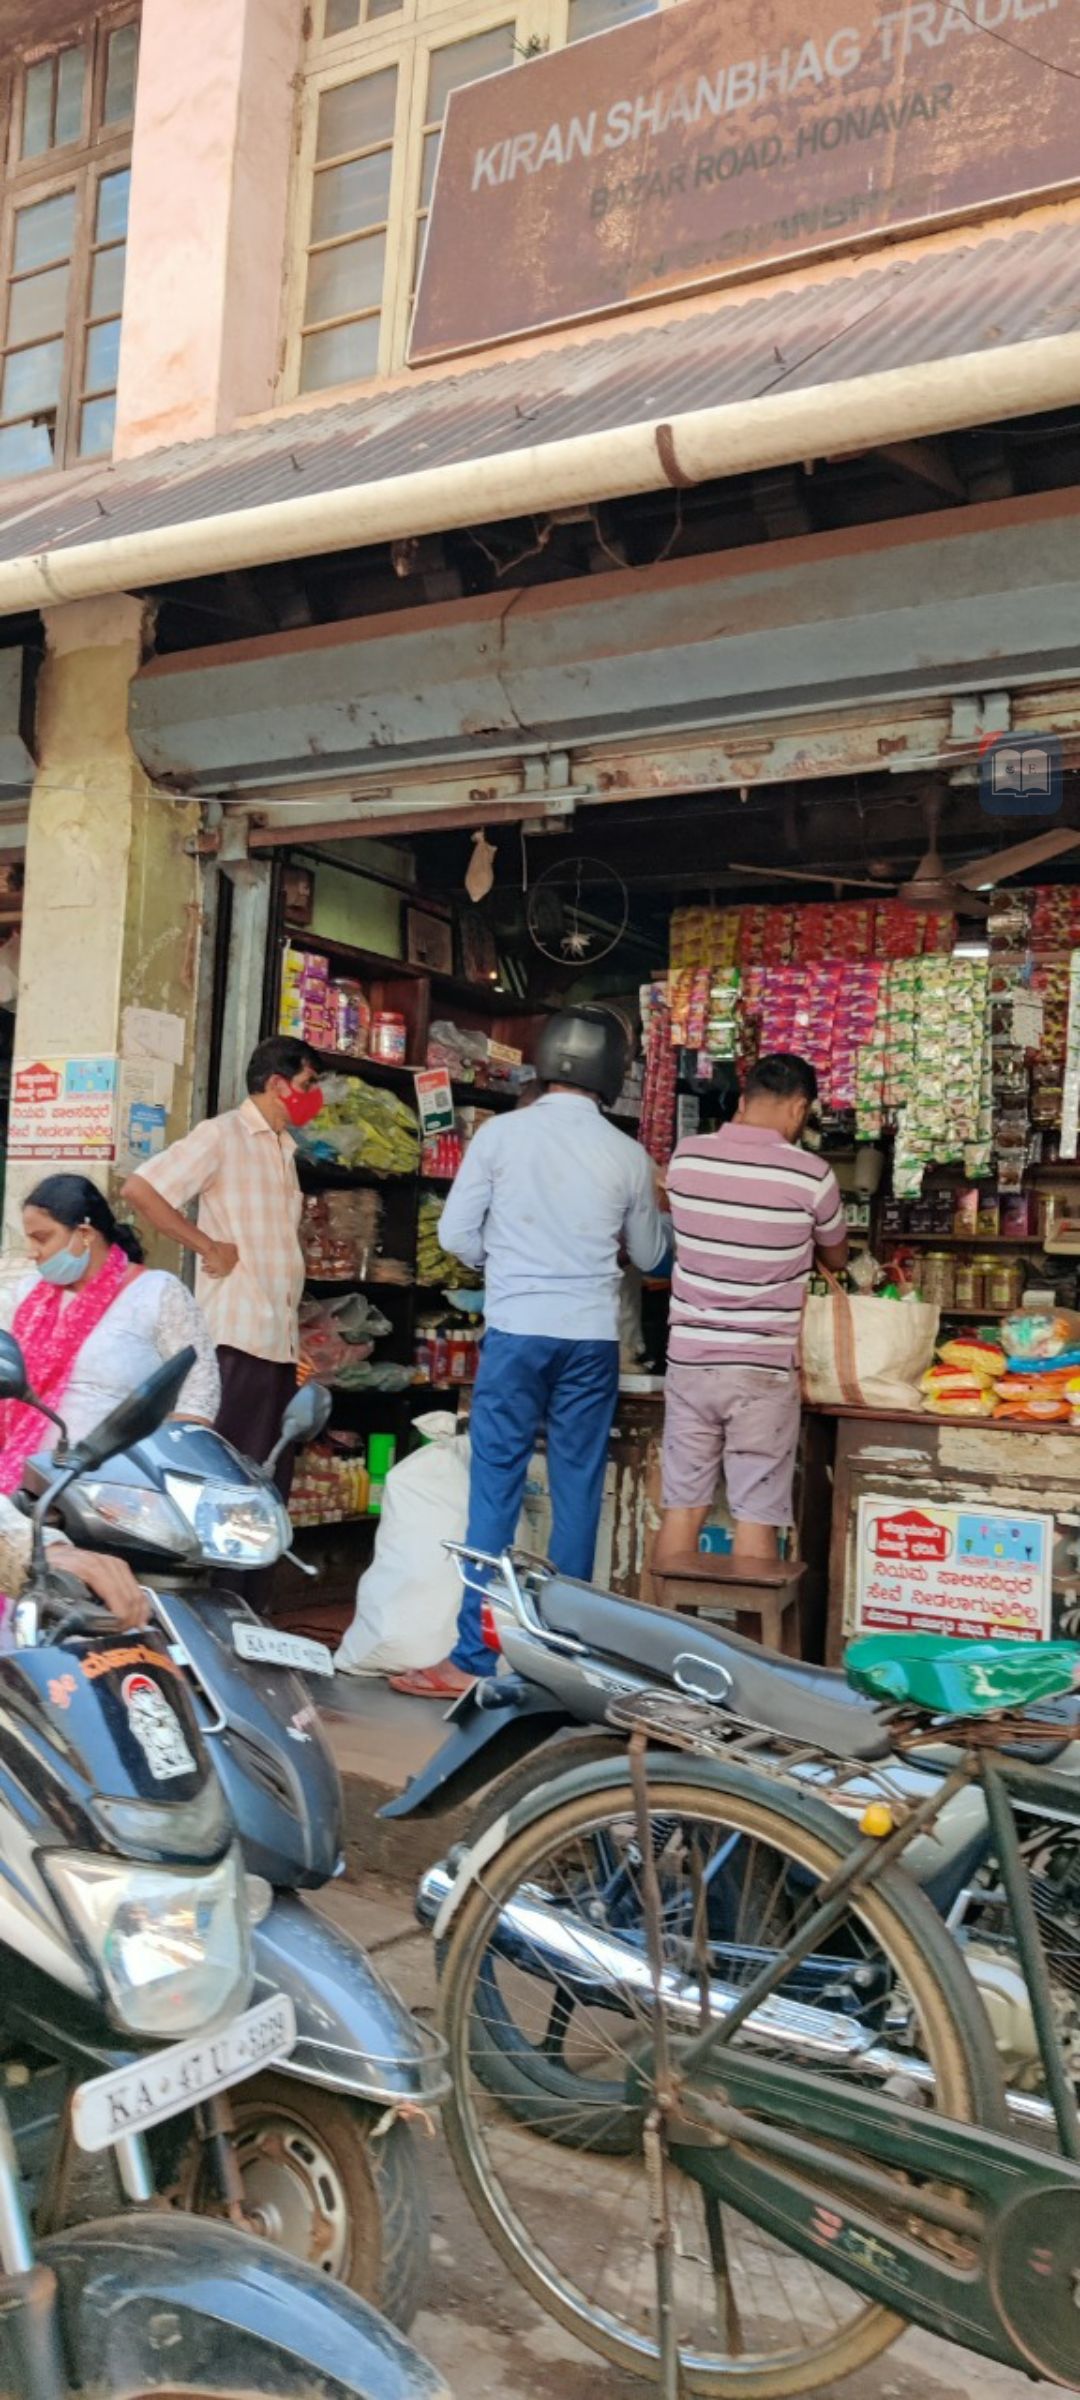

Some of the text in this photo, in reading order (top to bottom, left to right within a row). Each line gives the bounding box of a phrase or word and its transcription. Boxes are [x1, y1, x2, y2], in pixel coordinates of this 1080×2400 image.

[470, 0, 1059, 192] KIRAN SHANBHAG TRAD
[693, 137, 786, 189] ROAD,
[798, 82, 955, 156] HONAVAR
[873, 1561, 928, 1582] ನಿಯಮ
